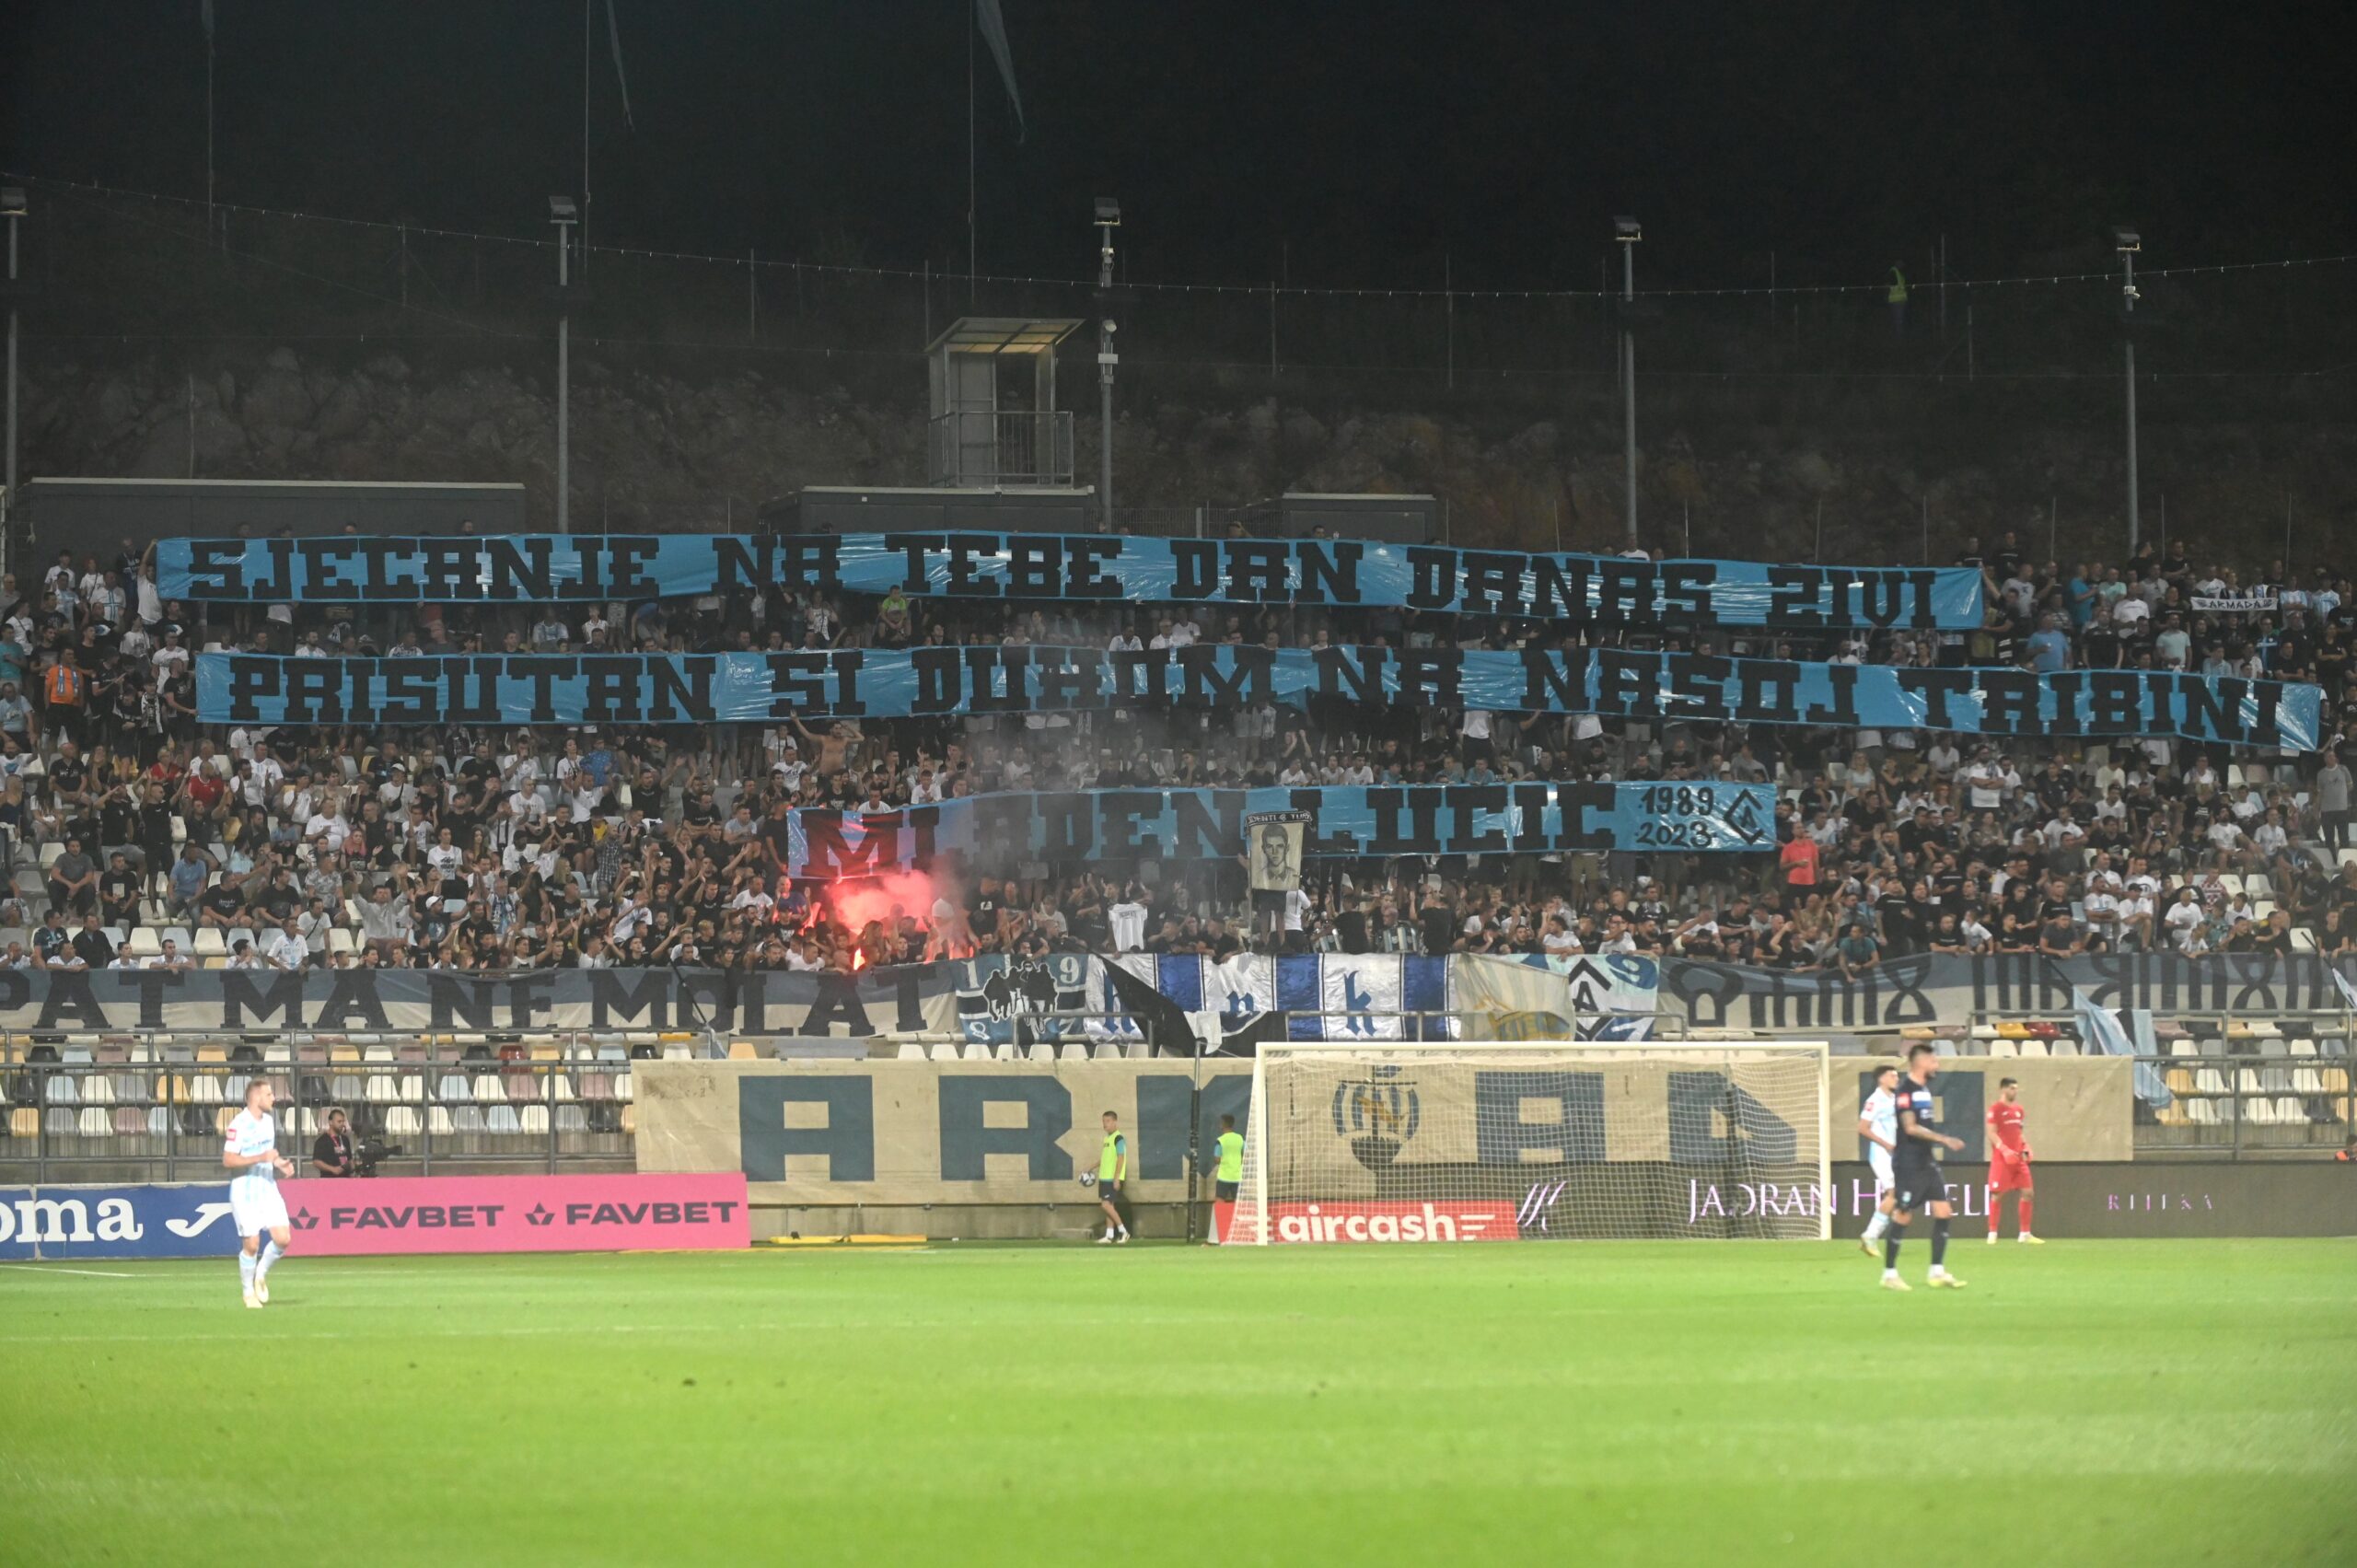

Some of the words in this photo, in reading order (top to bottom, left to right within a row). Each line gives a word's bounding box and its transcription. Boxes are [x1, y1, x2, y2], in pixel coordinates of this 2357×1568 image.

[188, 537, 660, 600] SJECANJE
[711, 534, 842, 591] NA
[885, 533, 1123, 598] TEBE
[1170, 539, 1364, 603] DAN
[1407, 547, 1717, 626] DANAS
[229, 656, 716, 722] PRISUTAN
[766, 651, 866, 718] SI
[911, 645, 1280, 715] DUHOM
[1318, 645, 1465, 710] NA
[1519, 647, 1860, 726] NASOJ
[1897, 668, 2282, 745] TRIBINI
[1641, 785, 1714, 816] 1989
[1635, 820, 1713, 848] 2023
[218, 970, 395, 1029] MA
[424, 971, 556, 1030] NE
[331, 1205, 504, 1229] FAVBET
[566, 1202, 738, 1225] FAVBET
[1278, 1203, 1457, 1241] aircash
